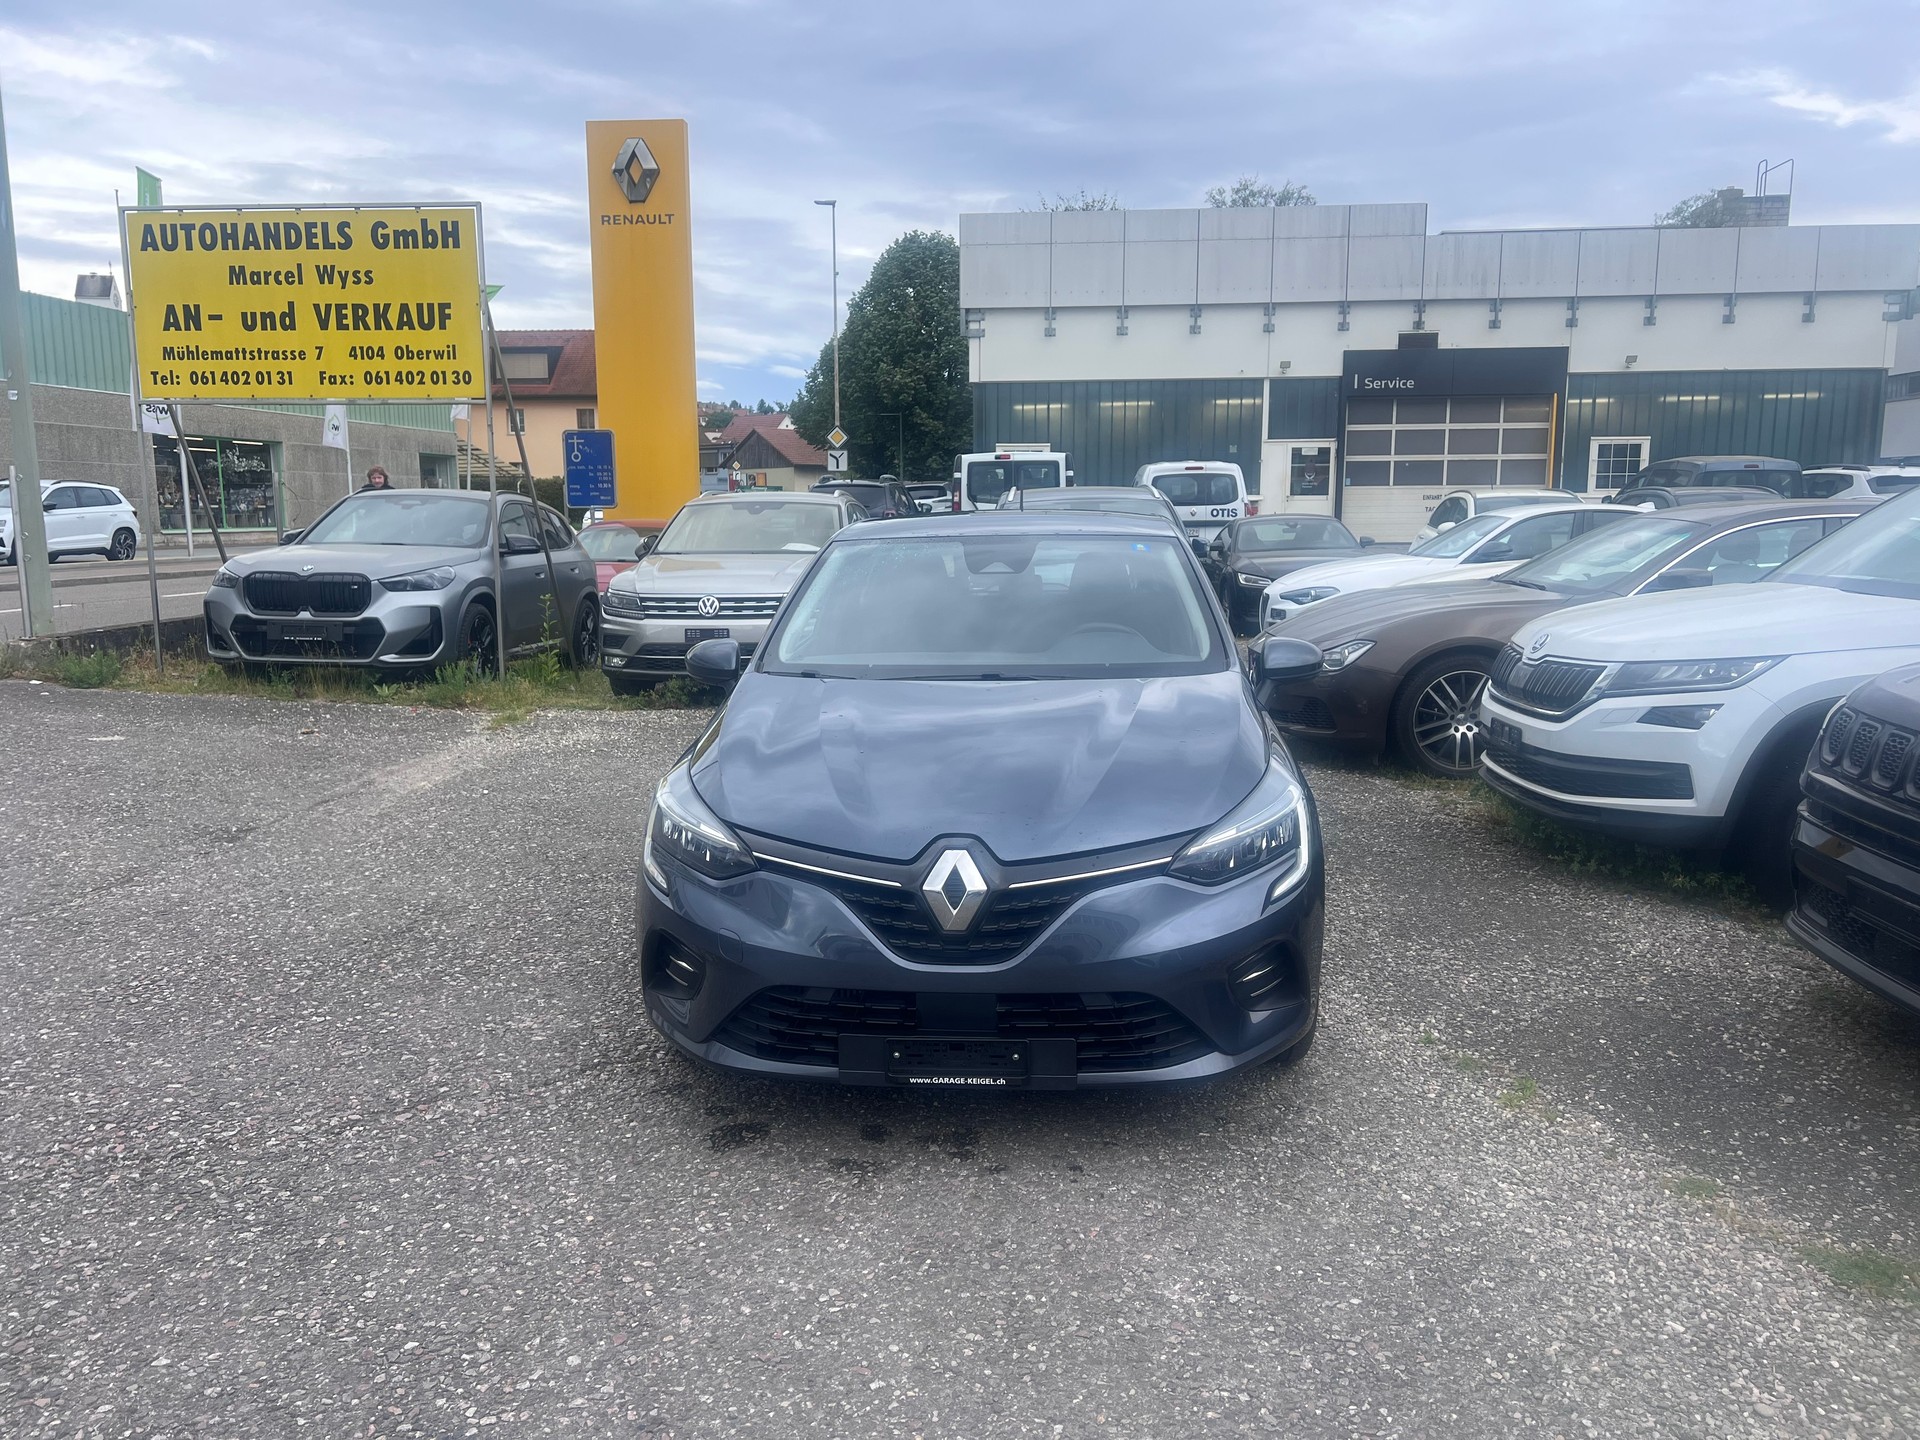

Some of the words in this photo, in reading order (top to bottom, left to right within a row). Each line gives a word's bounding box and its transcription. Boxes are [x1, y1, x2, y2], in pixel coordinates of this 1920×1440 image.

[601, 213, 675, 225] RENAULT
[140, 221, 353, 252] AUTOHANDELS
[370, 218, 461, 250] GmbH
[228, 263, 303, 286] Marcel
[314, 264, 374, 290] Wyss
[162, 303, 224, 332] AN-
[241, 301, 297, 331] und
[312, 302, 453, 331] VERKAUF
[162, 345, 307, 361] Mühlemattstrasse
[315, 346, 324, 361] 7
[348, 345, 386, 361] 4104
[394, 344, 457, 361] Oberwil
[150, 369, 181, 386] Tel:
[319, 370, 355, 386] Fax:
[1364, 376, 1415, 389] Service
[1210, 508, 1238, 518] OTIS
[909, 1077, 1006, 1085] www.GARAGE-KEIGEL.ch
